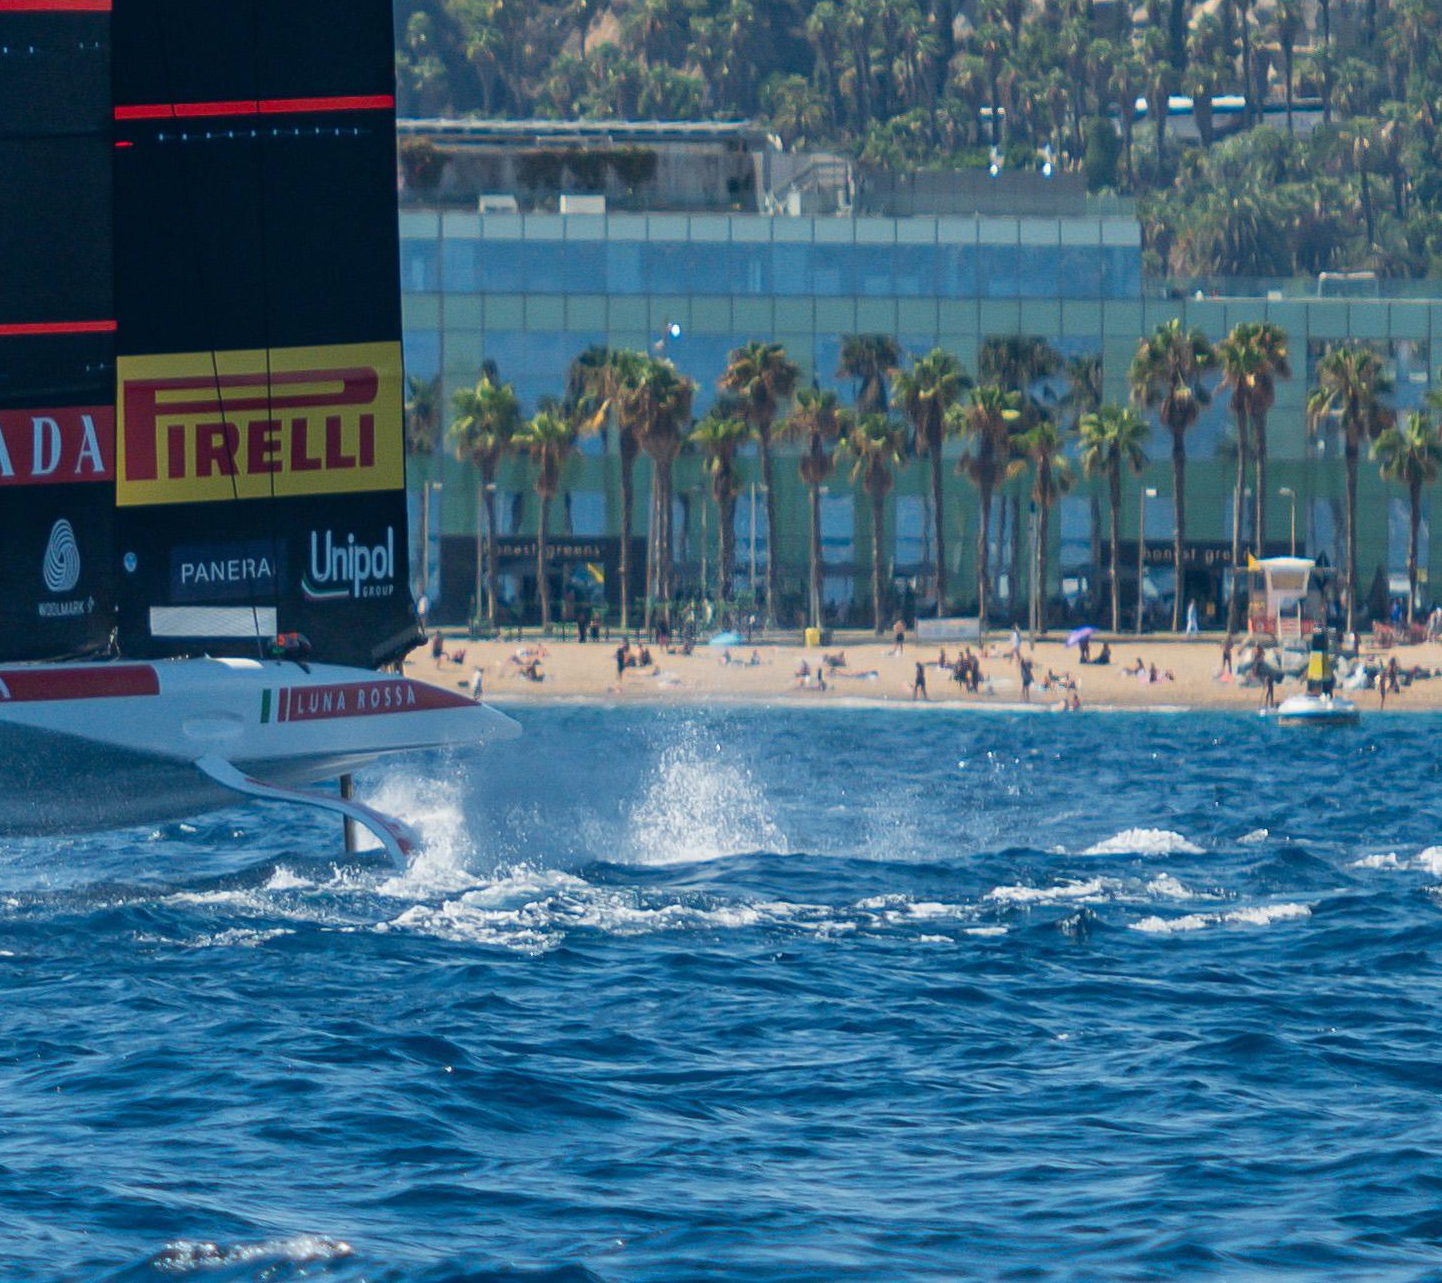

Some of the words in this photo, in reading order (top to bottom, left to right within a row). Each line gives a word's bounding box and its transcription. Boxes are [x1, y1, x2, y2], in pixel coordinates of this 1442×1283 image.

[123, 366, 379, 482] PIRELLI
[181, 557, 272, 584] PANERA
[310, 526, 394, 598] Unipol
[297, 690, 346, 715] LUNA
[357, 685, 416, 710] ROSSA
